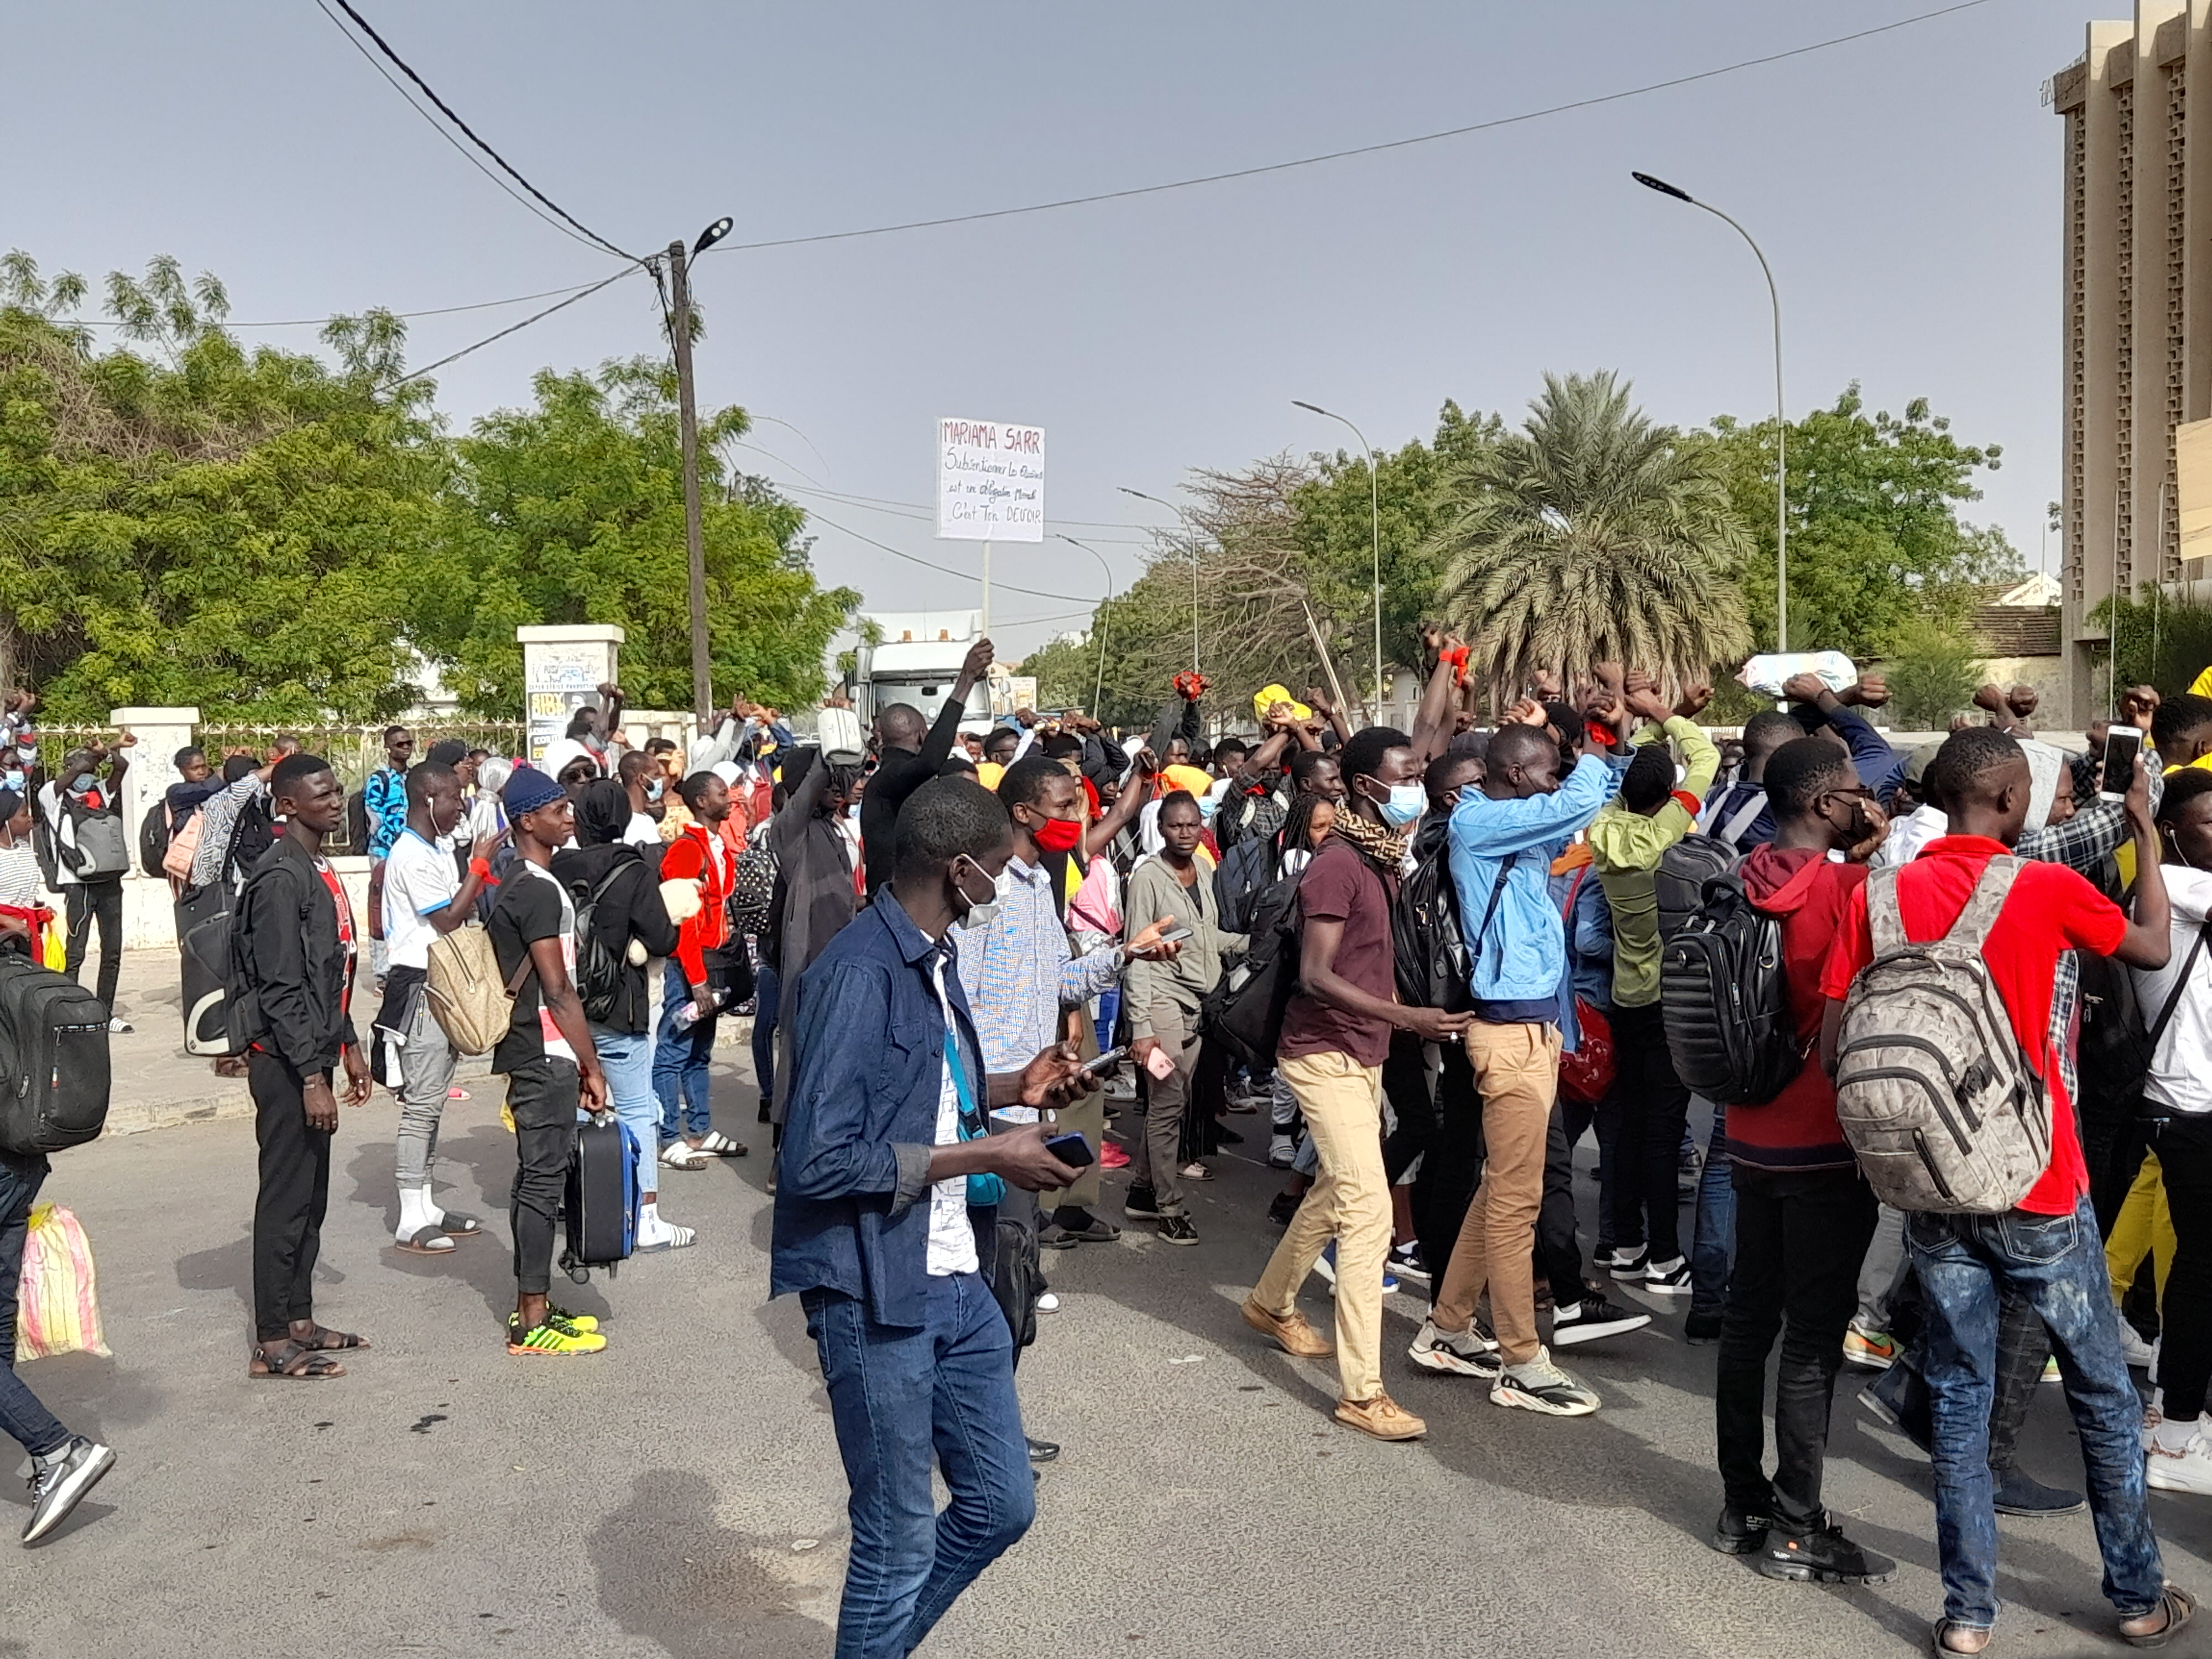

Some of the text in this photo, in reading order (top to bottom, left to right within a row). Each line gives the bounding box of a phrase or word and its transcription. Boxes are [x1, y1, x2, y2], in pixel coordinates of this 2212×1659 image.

[944, 421, 1040, 455] MARIAMA SARR
[531, 693, 564, 705] SIDY
